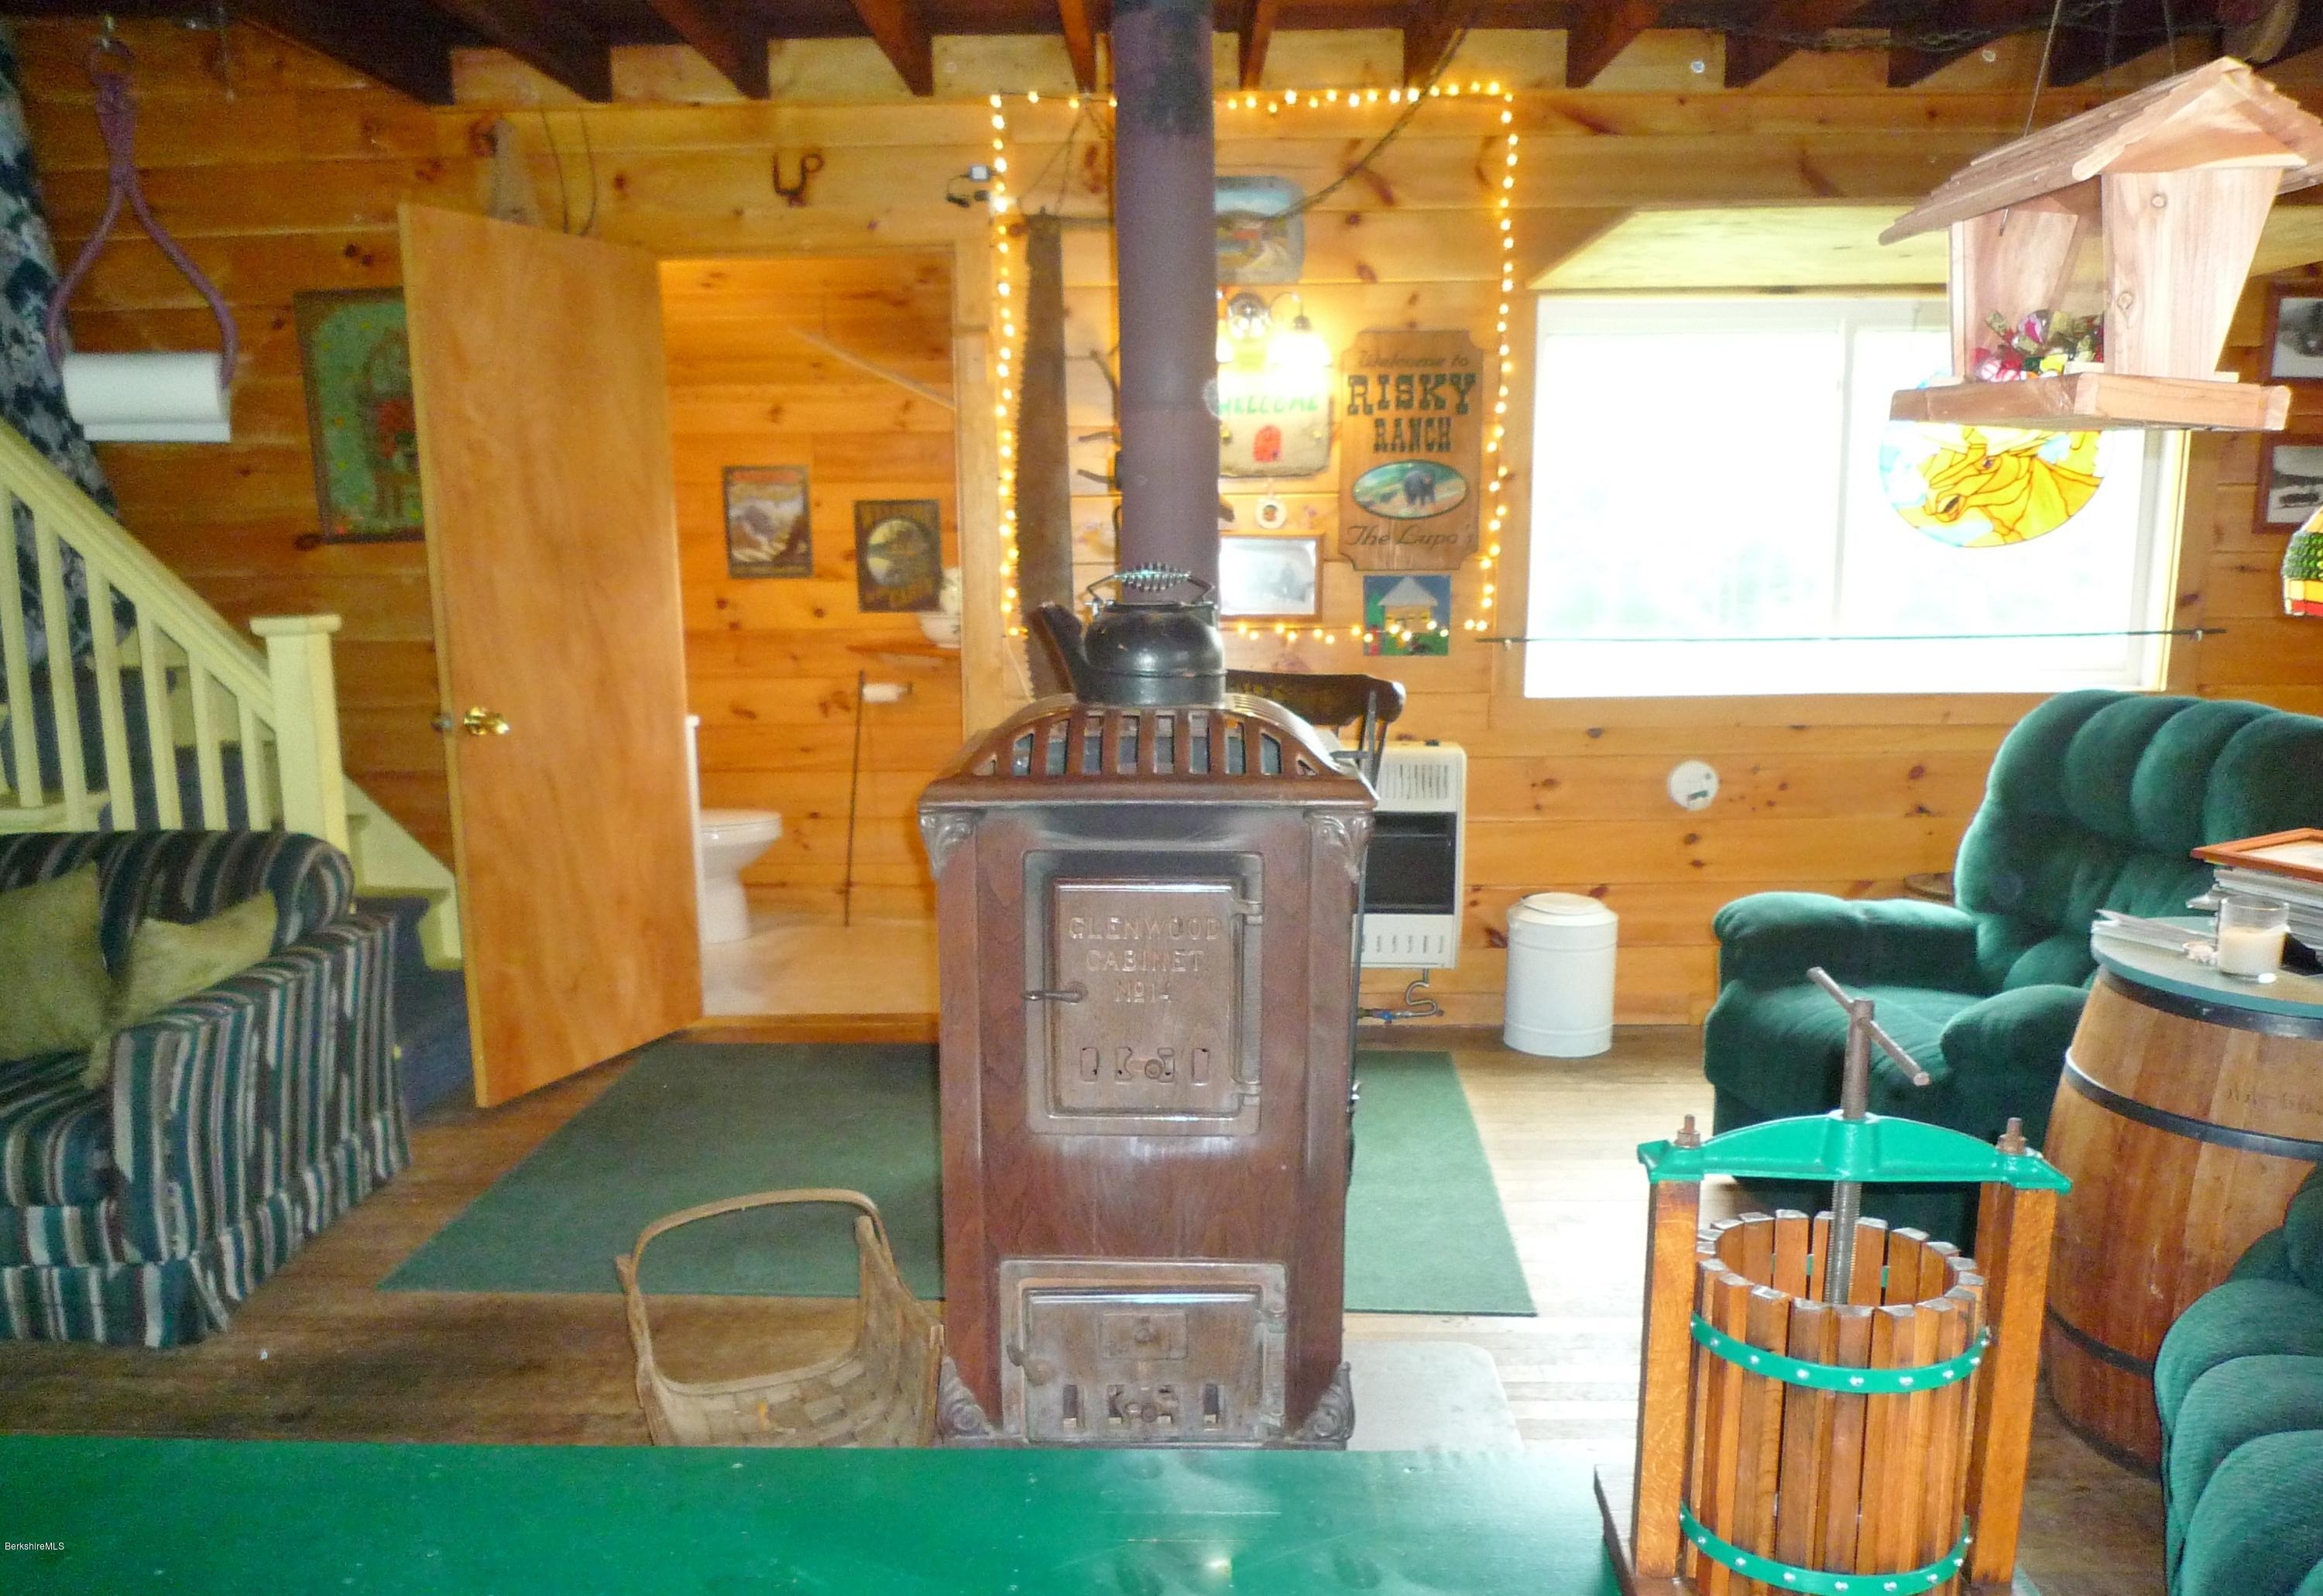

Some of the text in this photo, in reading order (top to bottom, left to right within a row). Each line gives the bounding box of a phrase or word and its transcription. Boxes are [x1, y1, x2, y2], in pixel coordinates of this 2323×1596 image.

[1450, 353, 1470, 367] to
[1347, 372, 1477, 416] RISKY
[1373, 417, 1453, 453] RANCH
[1346, 525, 1391, 546] The
[1068, 916, 1222, 940] GLENWOOD
[1086, 949, 1205, 972] CABINET
